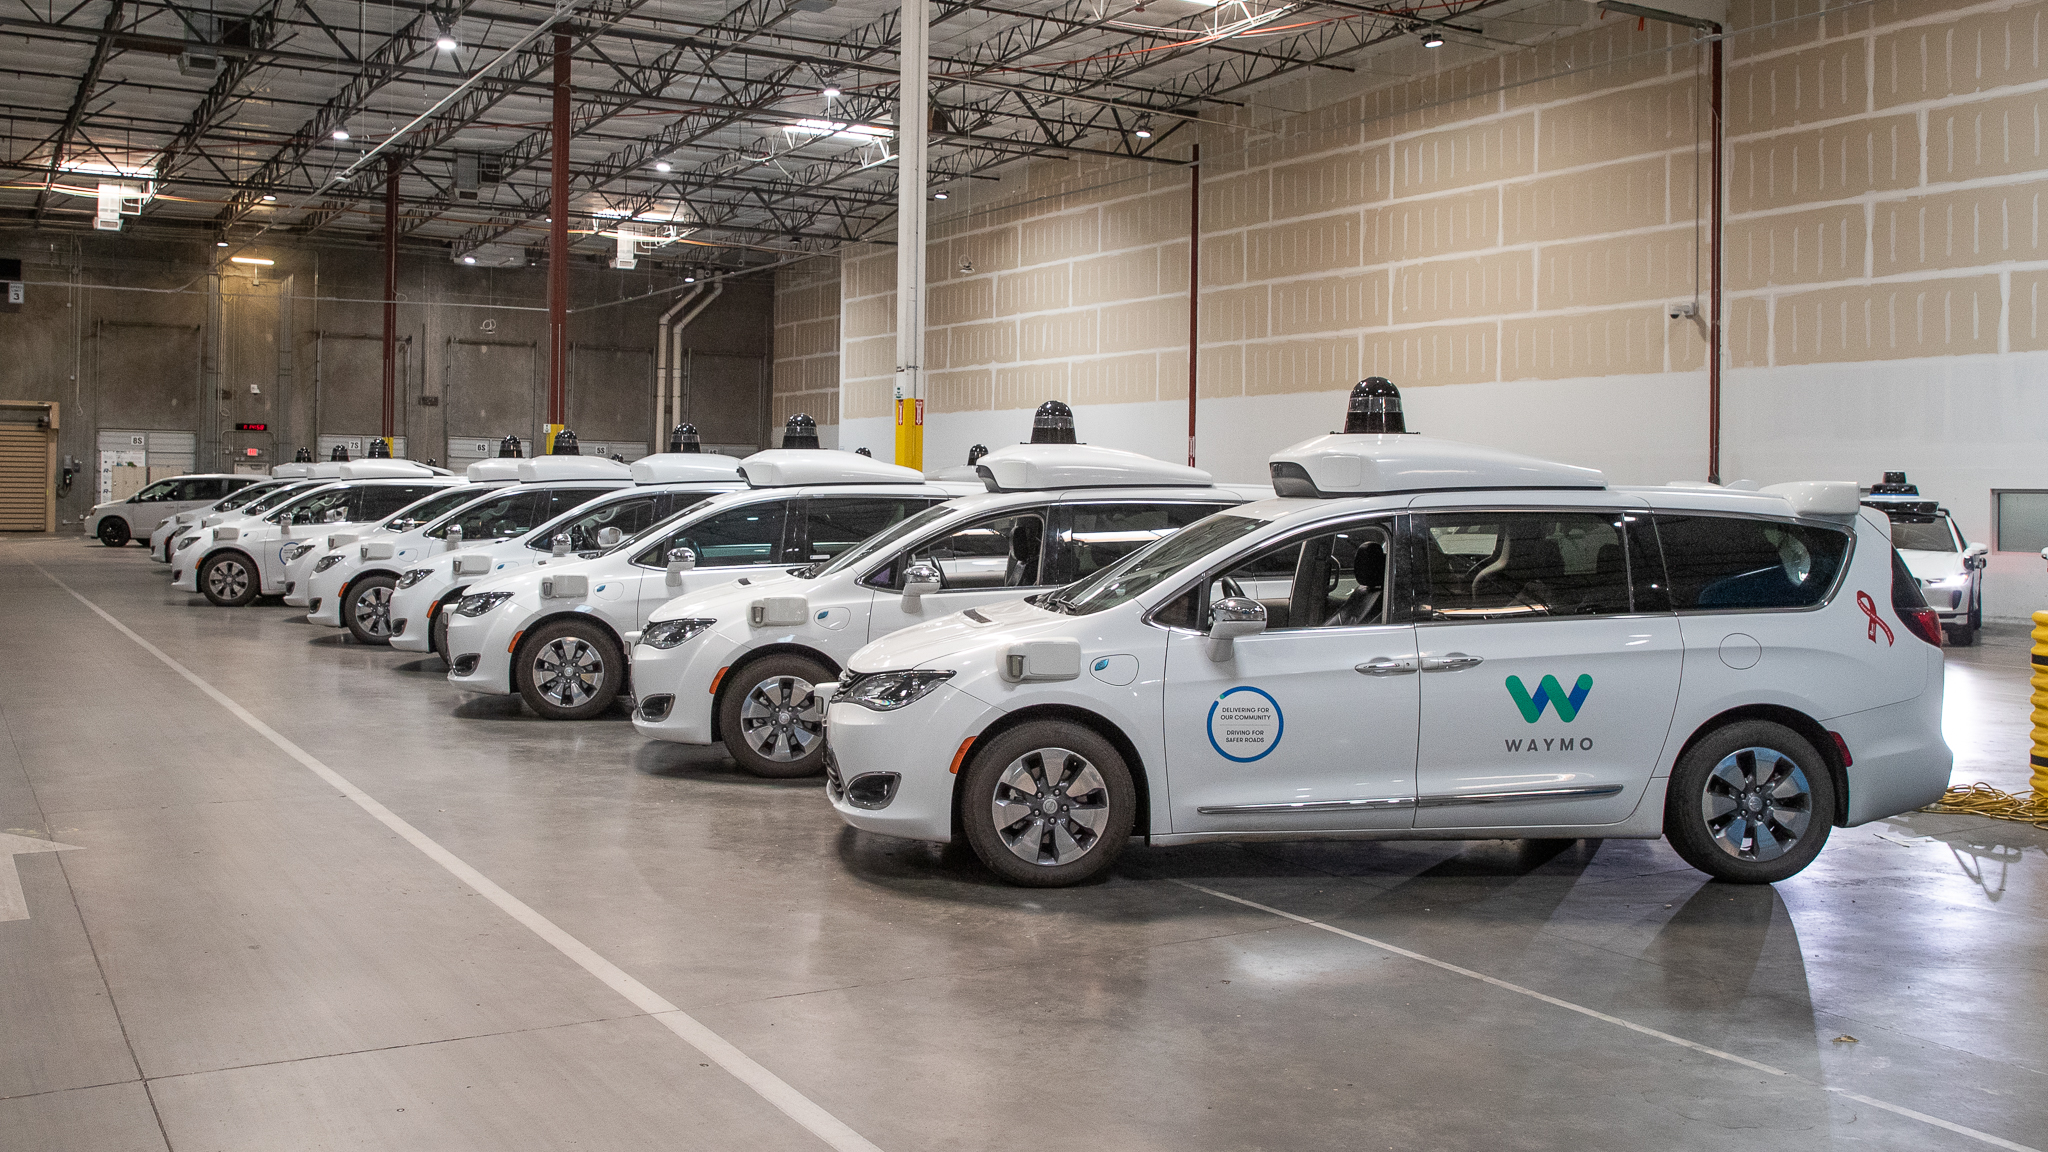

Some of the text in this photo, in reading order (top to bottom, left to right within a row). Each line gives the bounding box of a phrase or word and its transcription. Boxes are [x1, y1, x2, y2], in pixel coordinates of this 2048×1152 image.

[13, 292, 20, 300] 3
[133, 437, 143, 445] 8S
[1505, 737, 1593, 752] WAYMO
